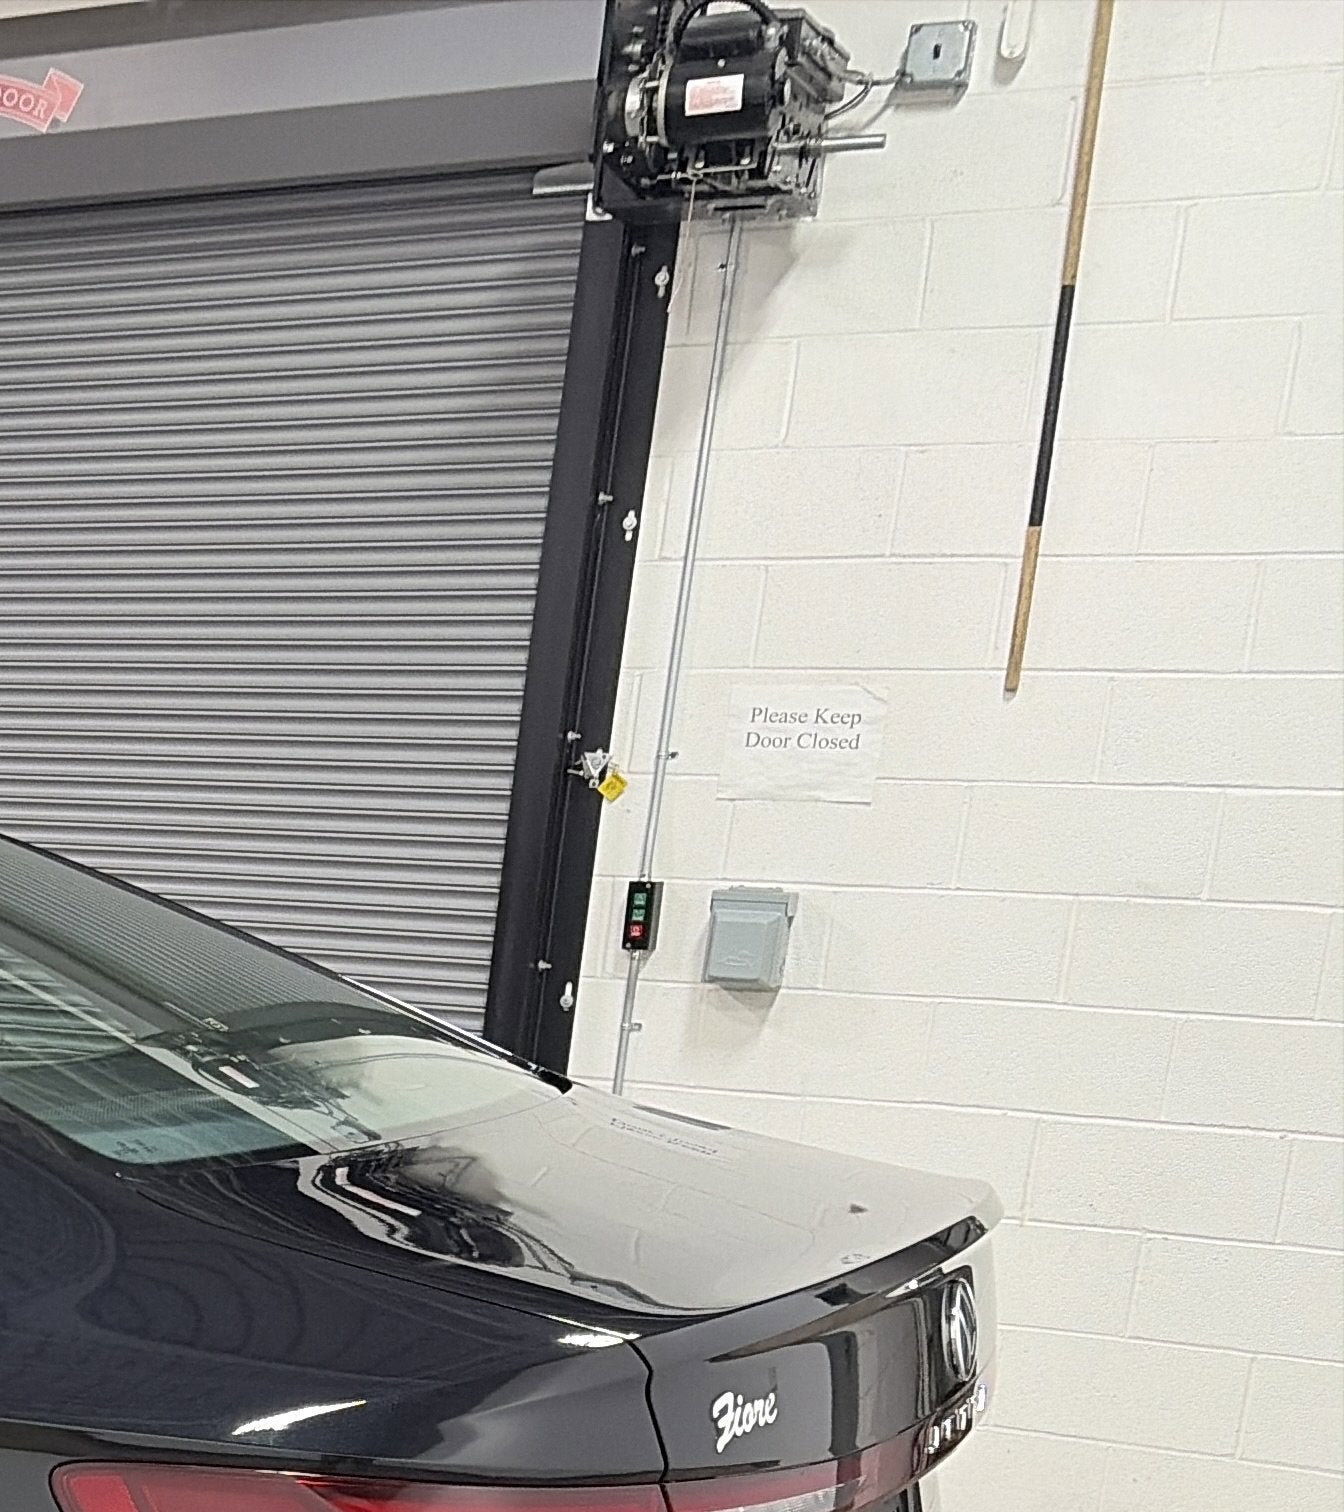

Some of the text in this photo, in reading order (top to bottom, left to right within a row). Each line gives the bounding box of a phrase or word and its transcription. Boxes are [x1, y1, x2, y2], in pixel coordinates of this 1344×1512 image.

[750, 706, 862, 729] Please Keep
[744, 731, 861, 750] Door Closed
[712, 1391, 778, 1453] Fiore
